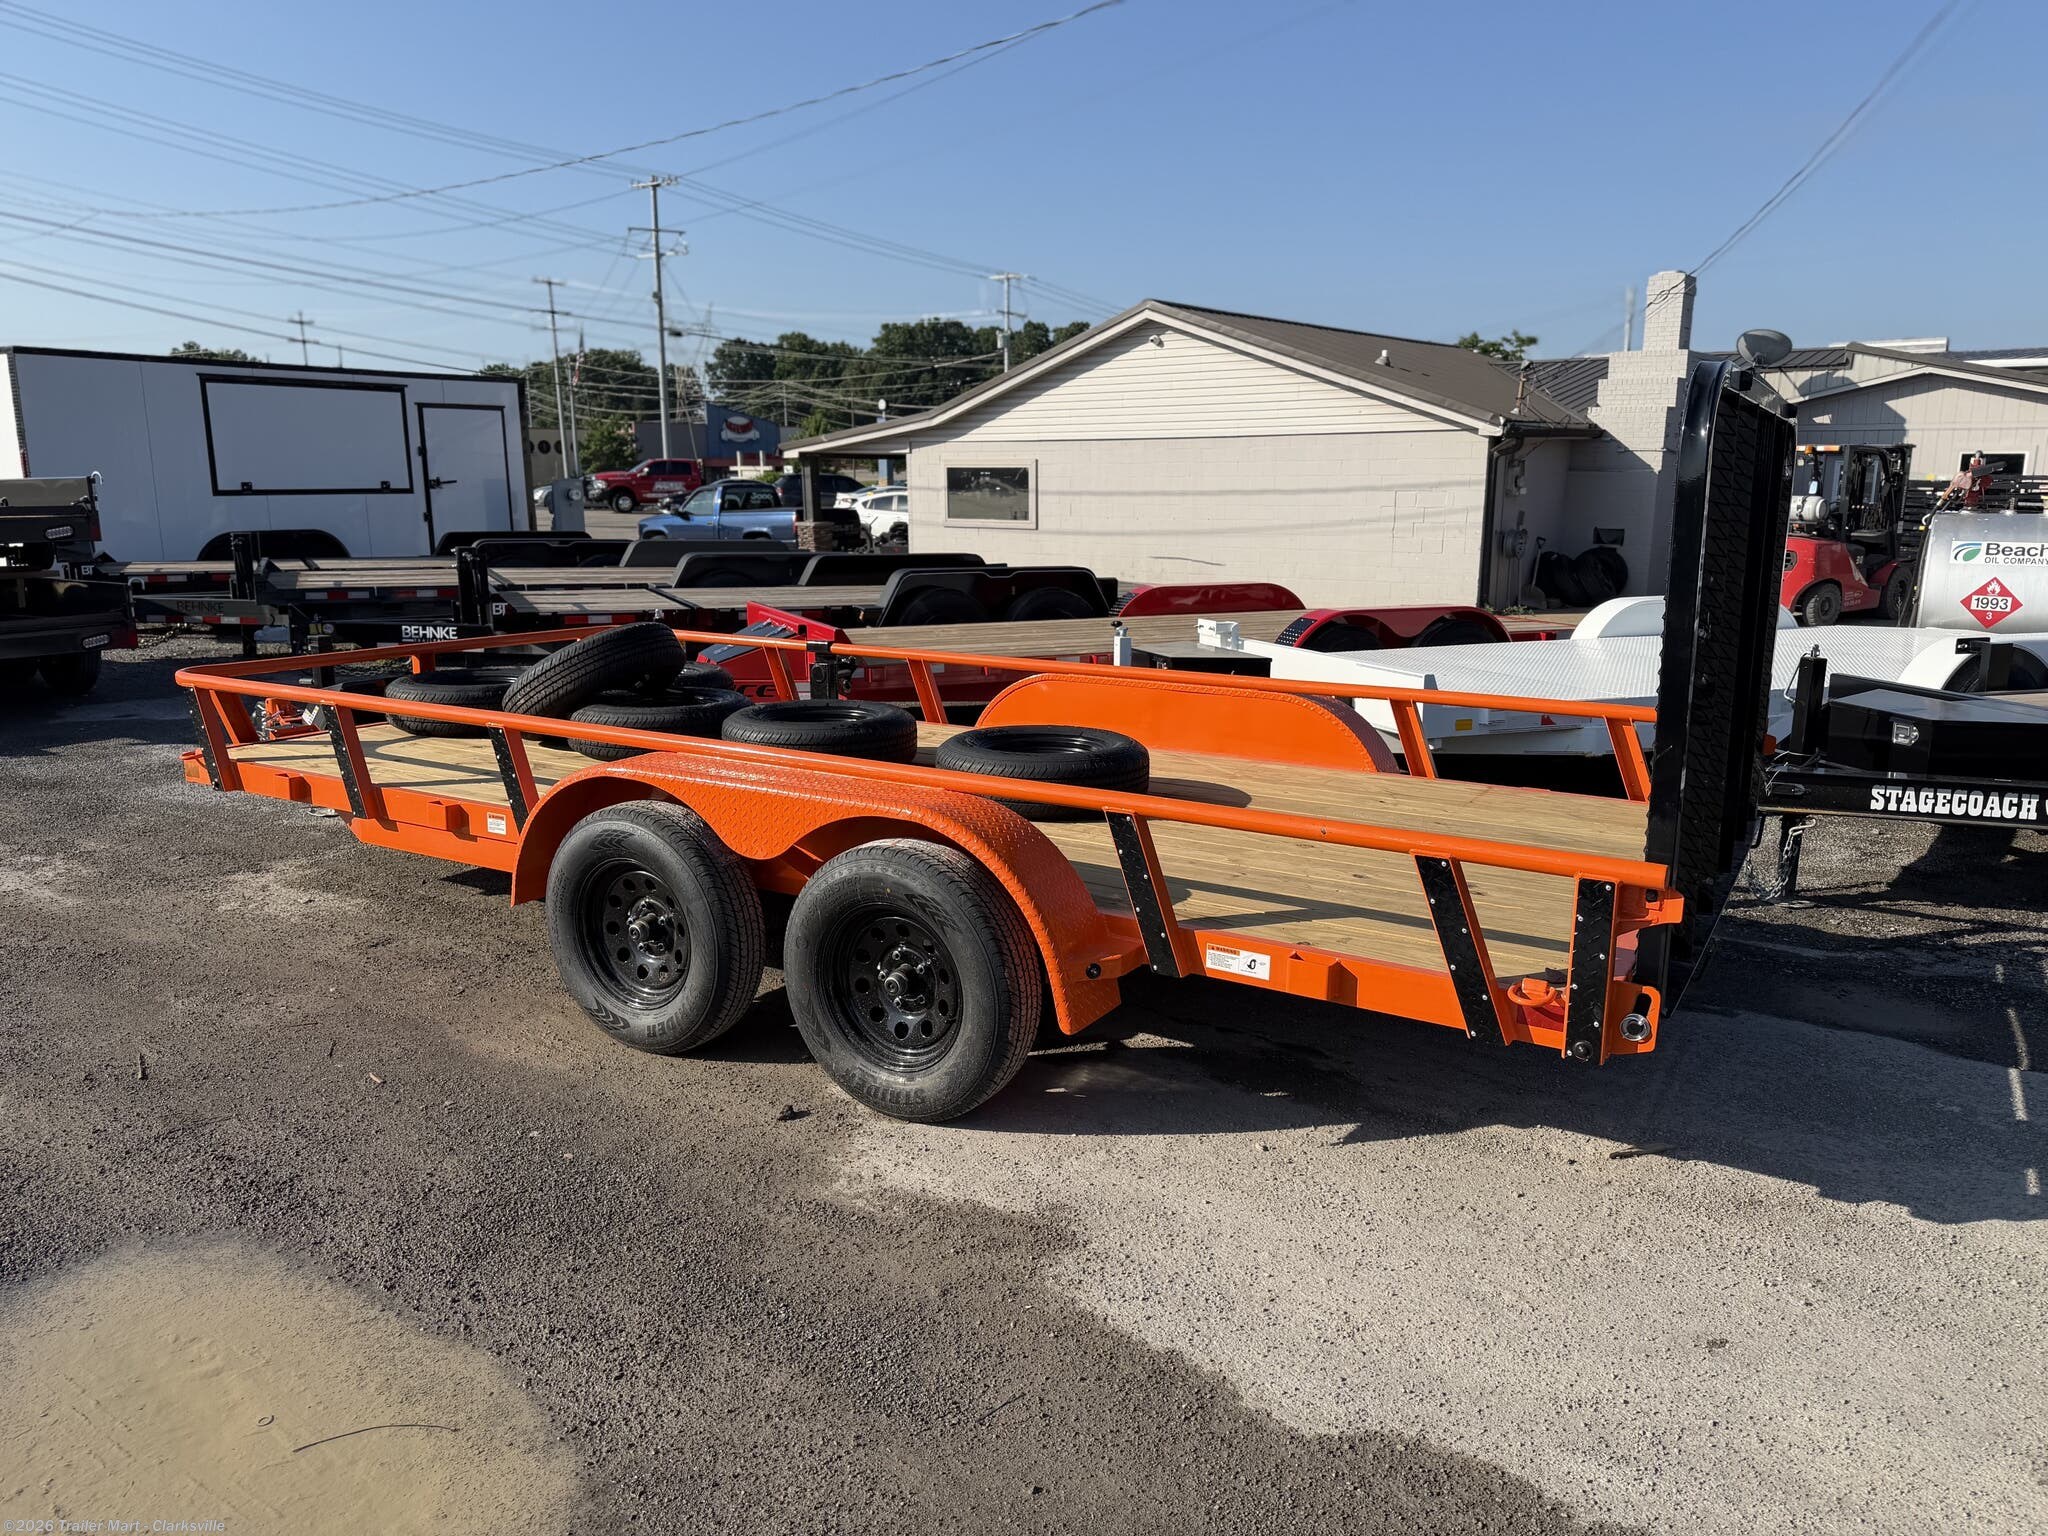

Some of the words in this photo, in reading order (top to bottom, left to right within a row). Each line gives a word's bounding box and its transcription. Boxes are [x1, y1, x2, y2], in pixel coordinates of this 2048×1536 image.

[1985, 542, 2048, 557] Beach
[1984, 556, 2000, 564] OIL
[81, 565, 94, 575] BT
[492, 602, 508, 616] BT
[1974, 597, 2009, 610] 1993
[1985, 612, 1993, 620] 3
[401, 625, 458, 640] BEHNKE
[1870, 784, 2040, 821] STAGECOACH
